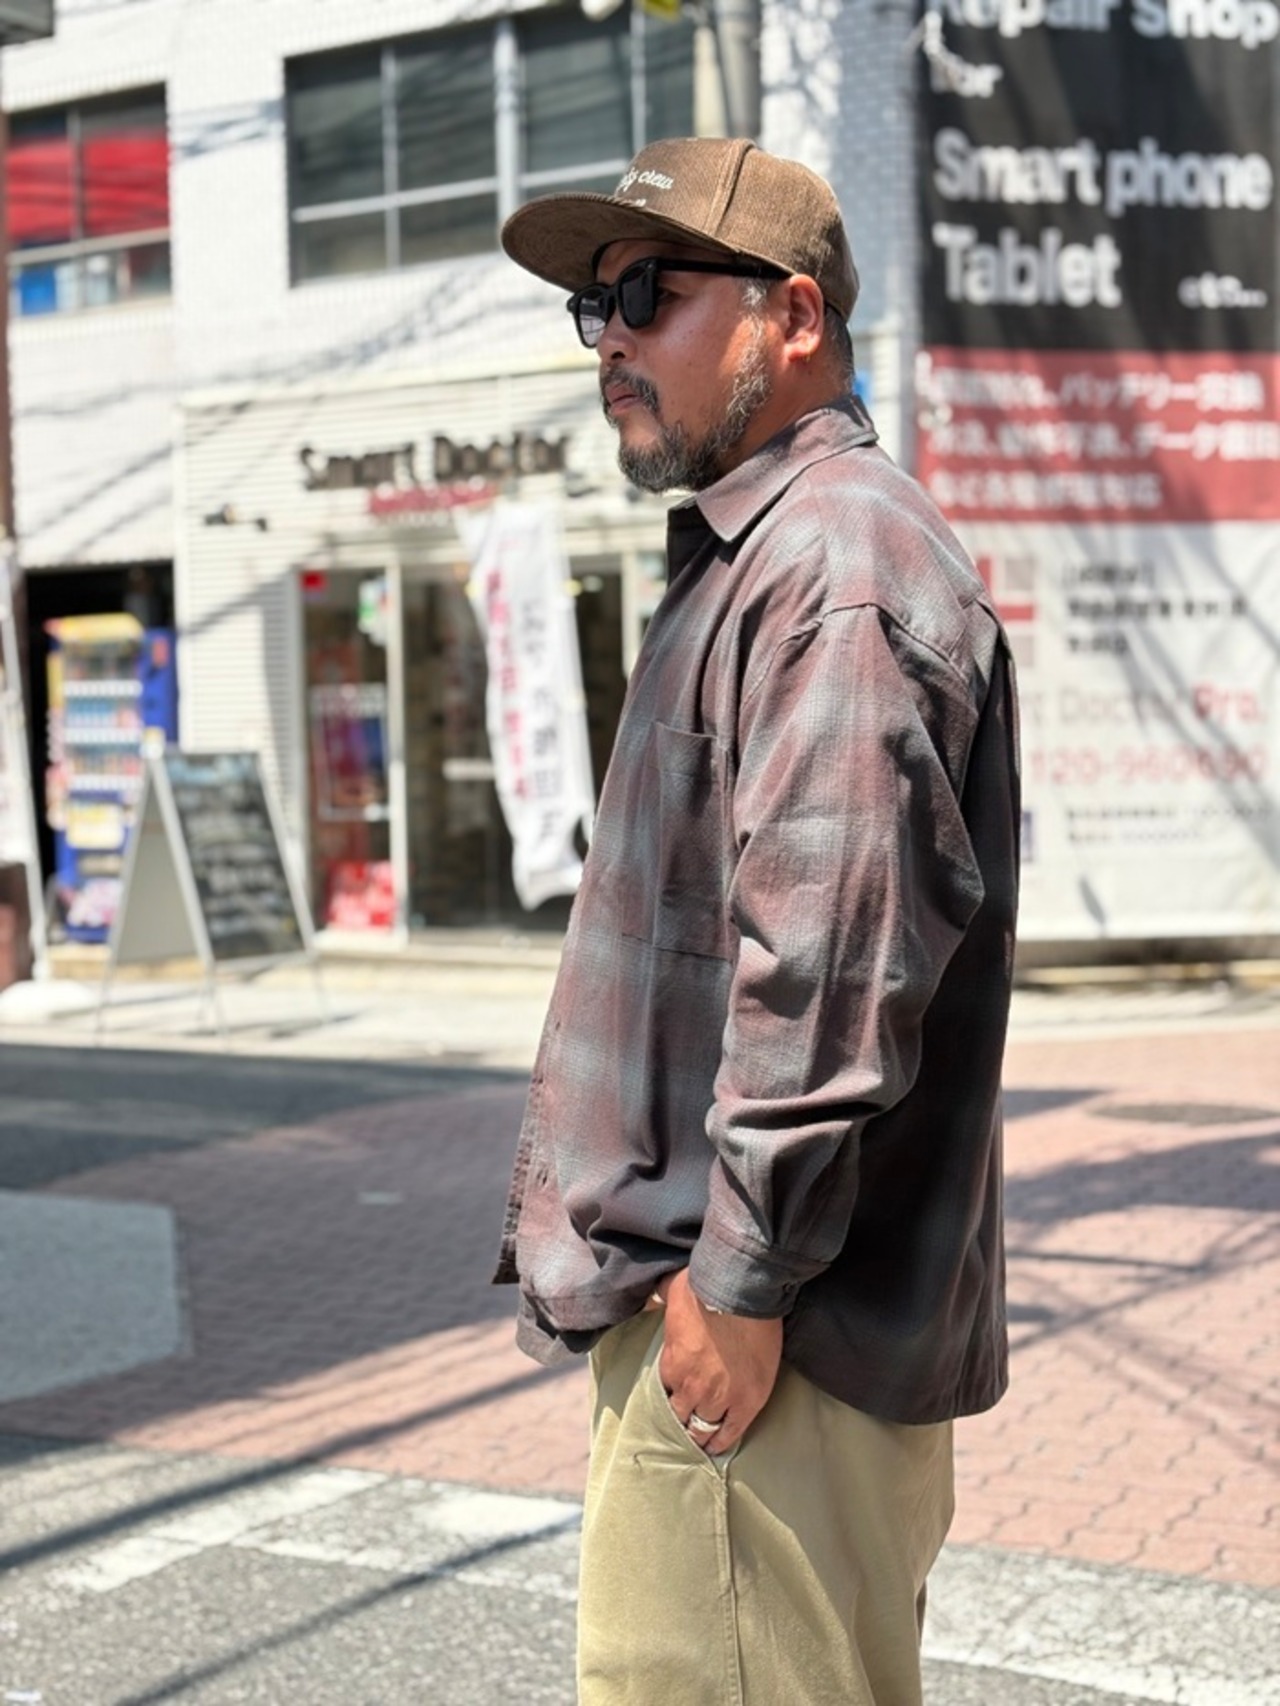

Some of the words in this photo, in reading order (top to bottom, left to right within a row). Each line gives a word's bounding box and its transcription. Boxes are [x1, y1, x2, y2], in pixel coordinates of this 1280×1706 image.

[933, 127, 1101, 206] Smart
[1106, 136, 1273, 218] phone
[932, 222, 1122, 308] Tablet
[300, 441, 417, 491] Smart
[433, 432, 568, 482] Doctor
